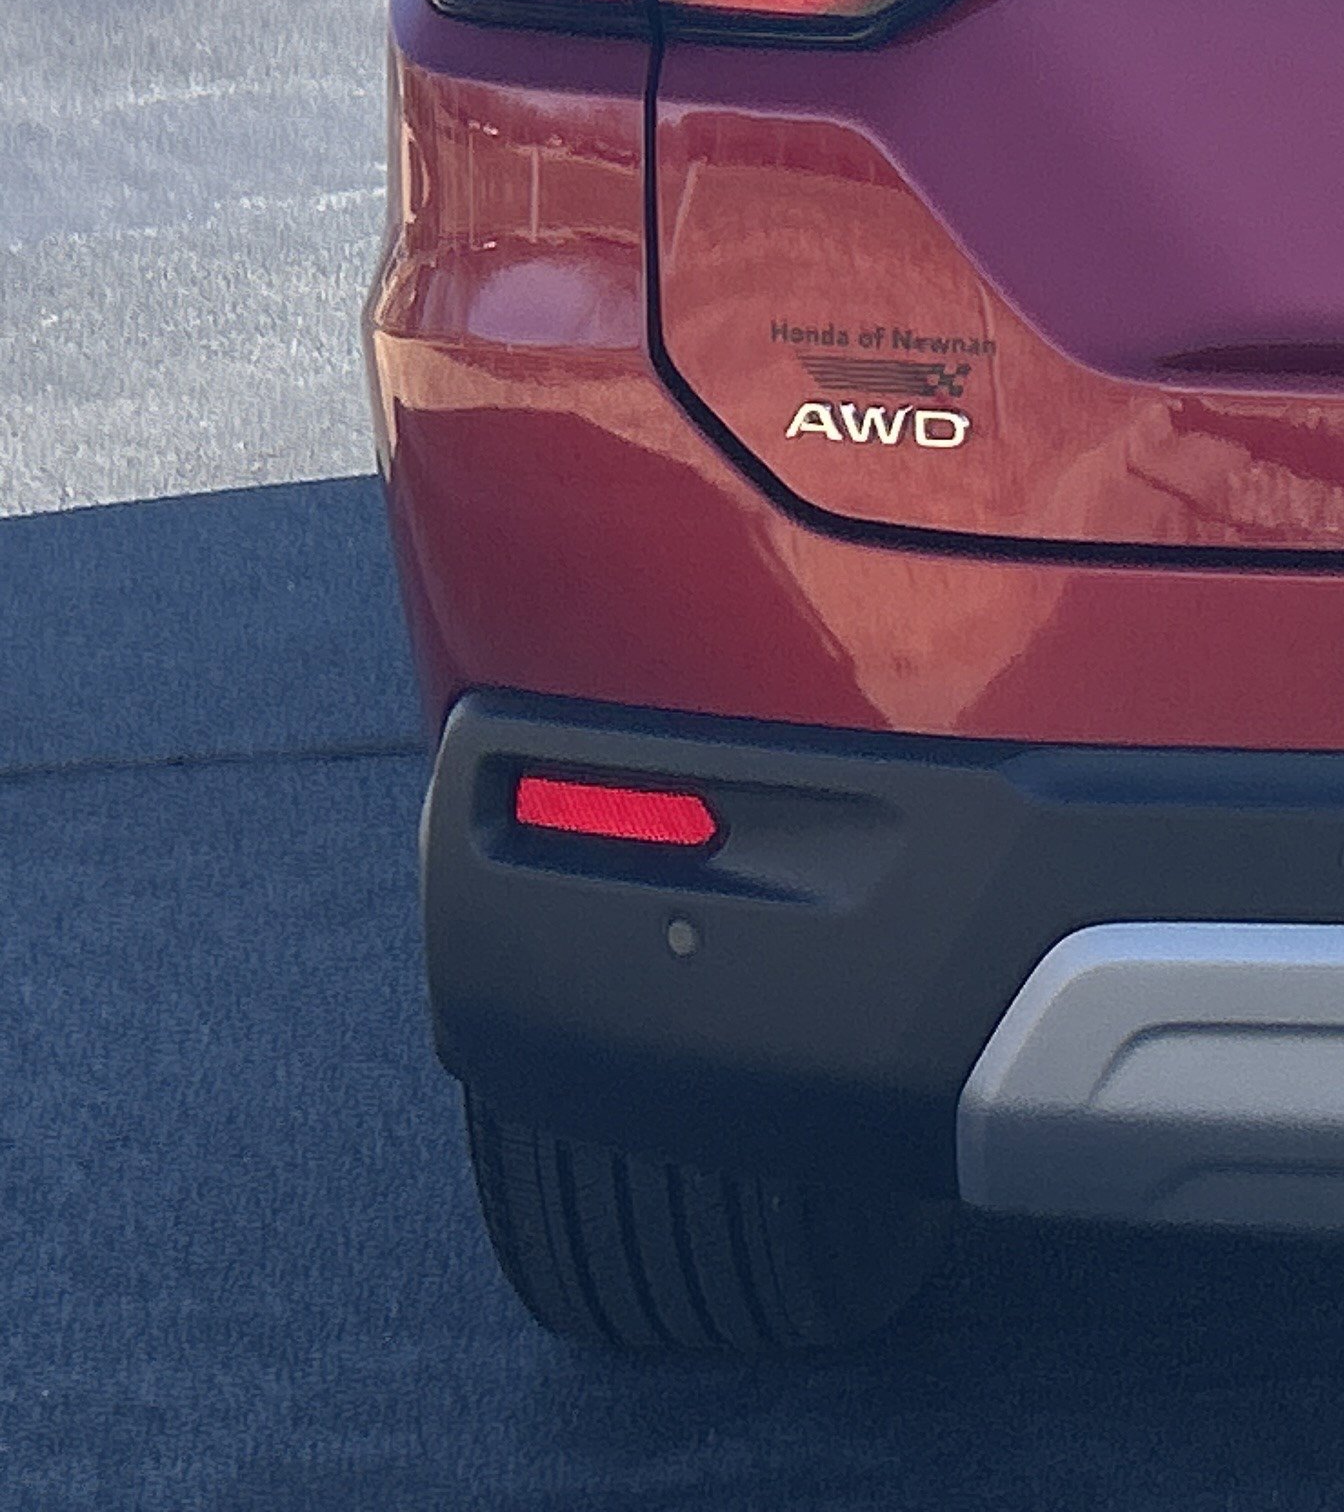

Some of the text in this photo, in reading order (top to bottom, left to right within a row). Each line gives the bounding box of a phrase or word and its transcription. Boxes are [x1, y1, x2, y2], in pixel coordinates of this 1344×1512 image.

[770, 319, 997, 356] Honda of Newnan
[784, 401, 971, 448] AWD
